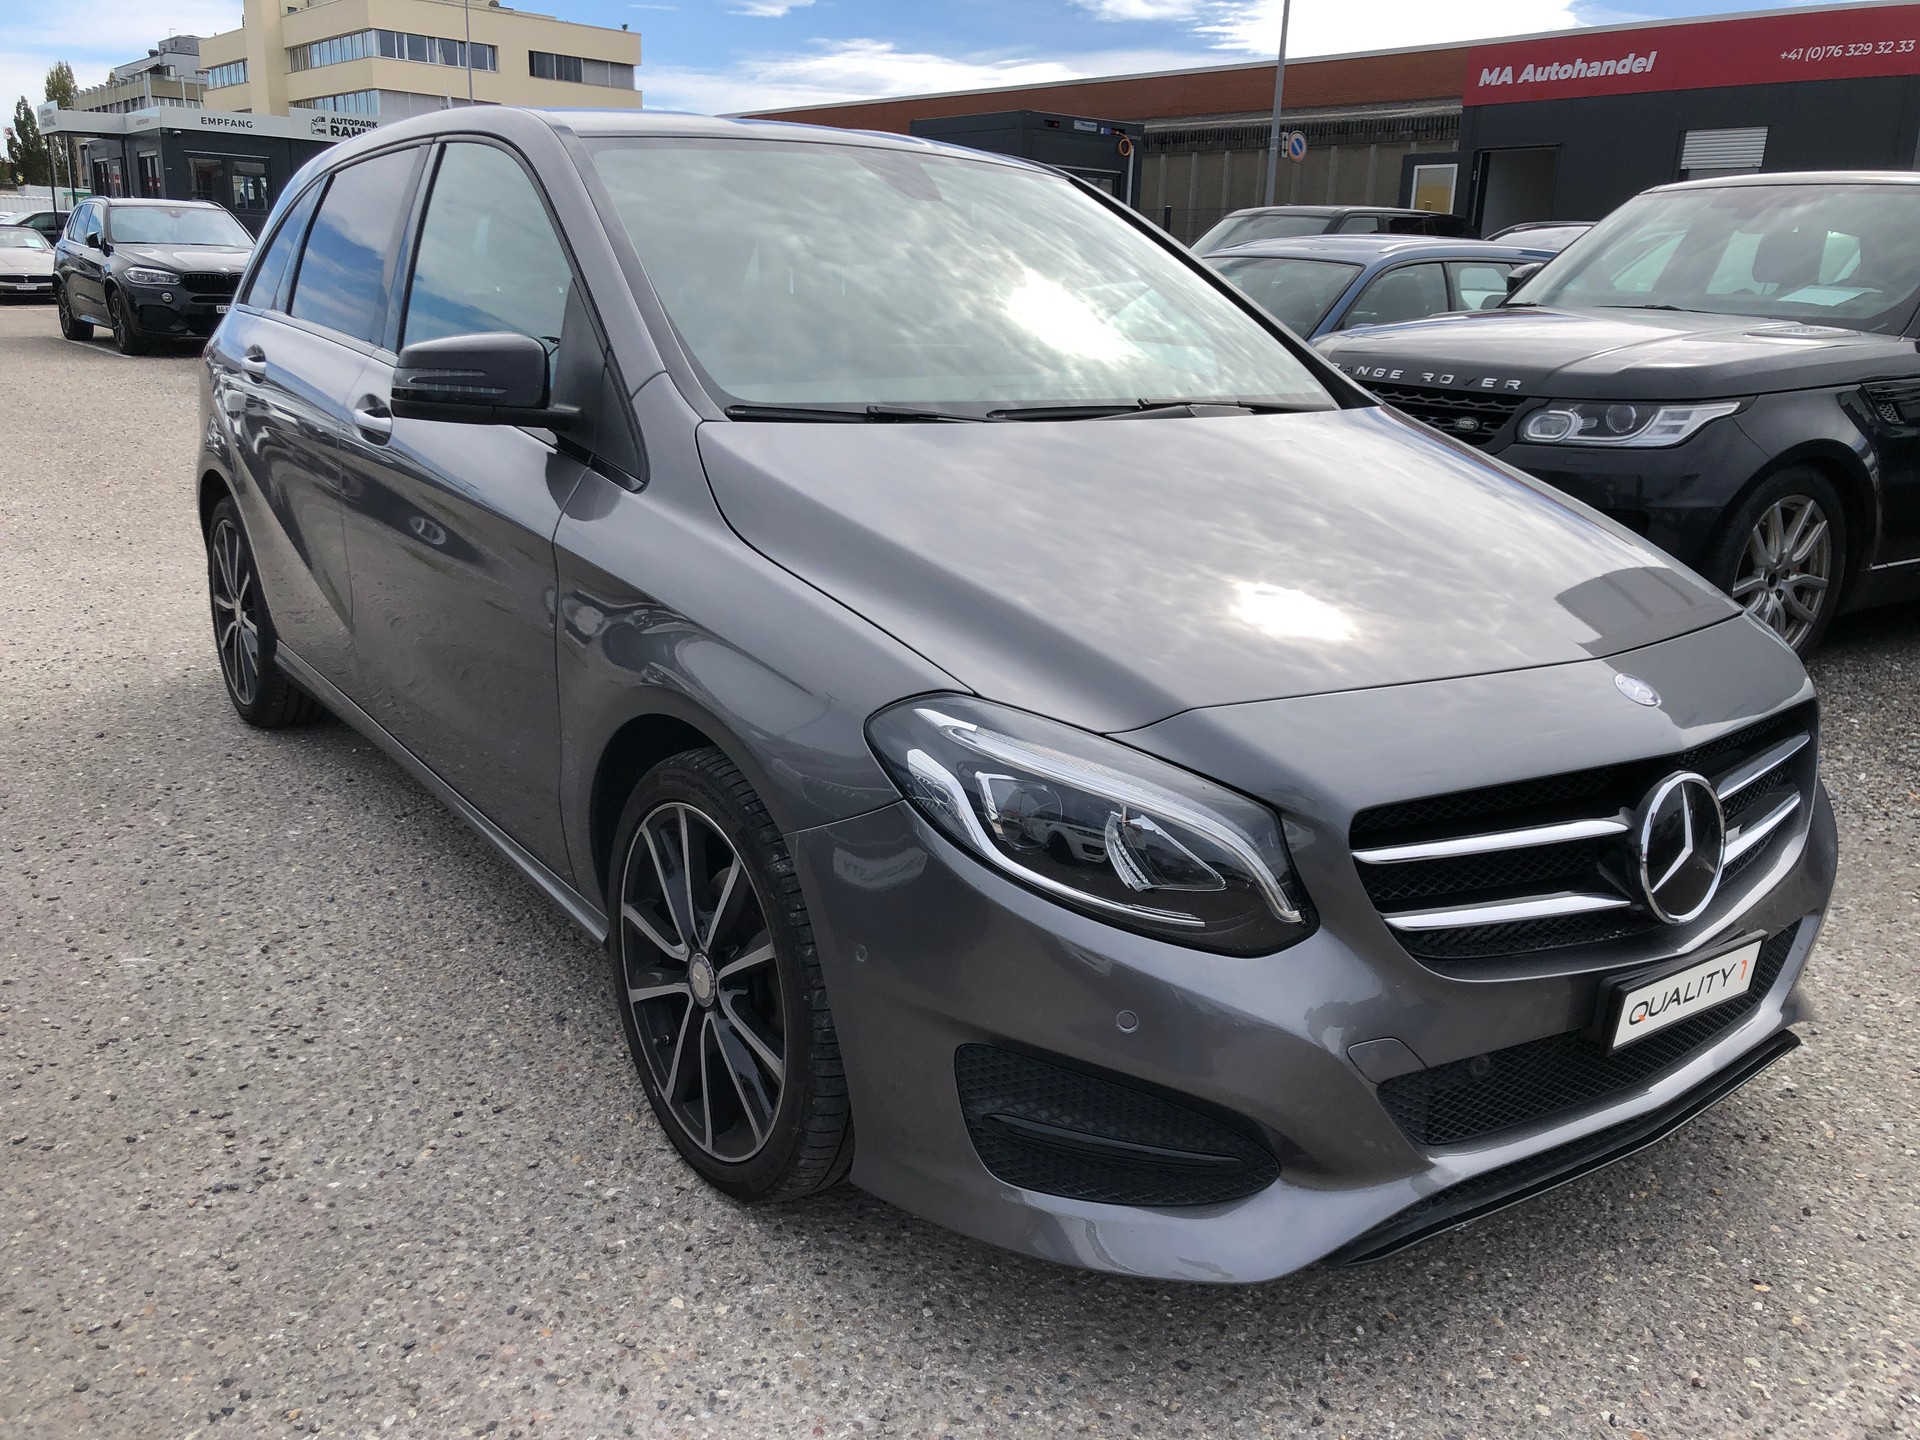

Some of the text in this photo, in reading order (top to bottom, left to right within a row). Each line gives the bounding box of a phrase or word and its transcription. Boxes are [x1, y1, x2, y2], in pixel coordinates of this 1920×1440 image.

[1780, 39, 1917, 62] +41 (0)76 329 32 33
[1478, 51, 1658, 87] MA Autohandel
[200, 116, 254, 129] EMPFANG
[330, 117, 378, 129] AUTOPARK
[1421, 372, 1522, 390] ROVER
[1628, 962, 1737, 1026] QUALITY
